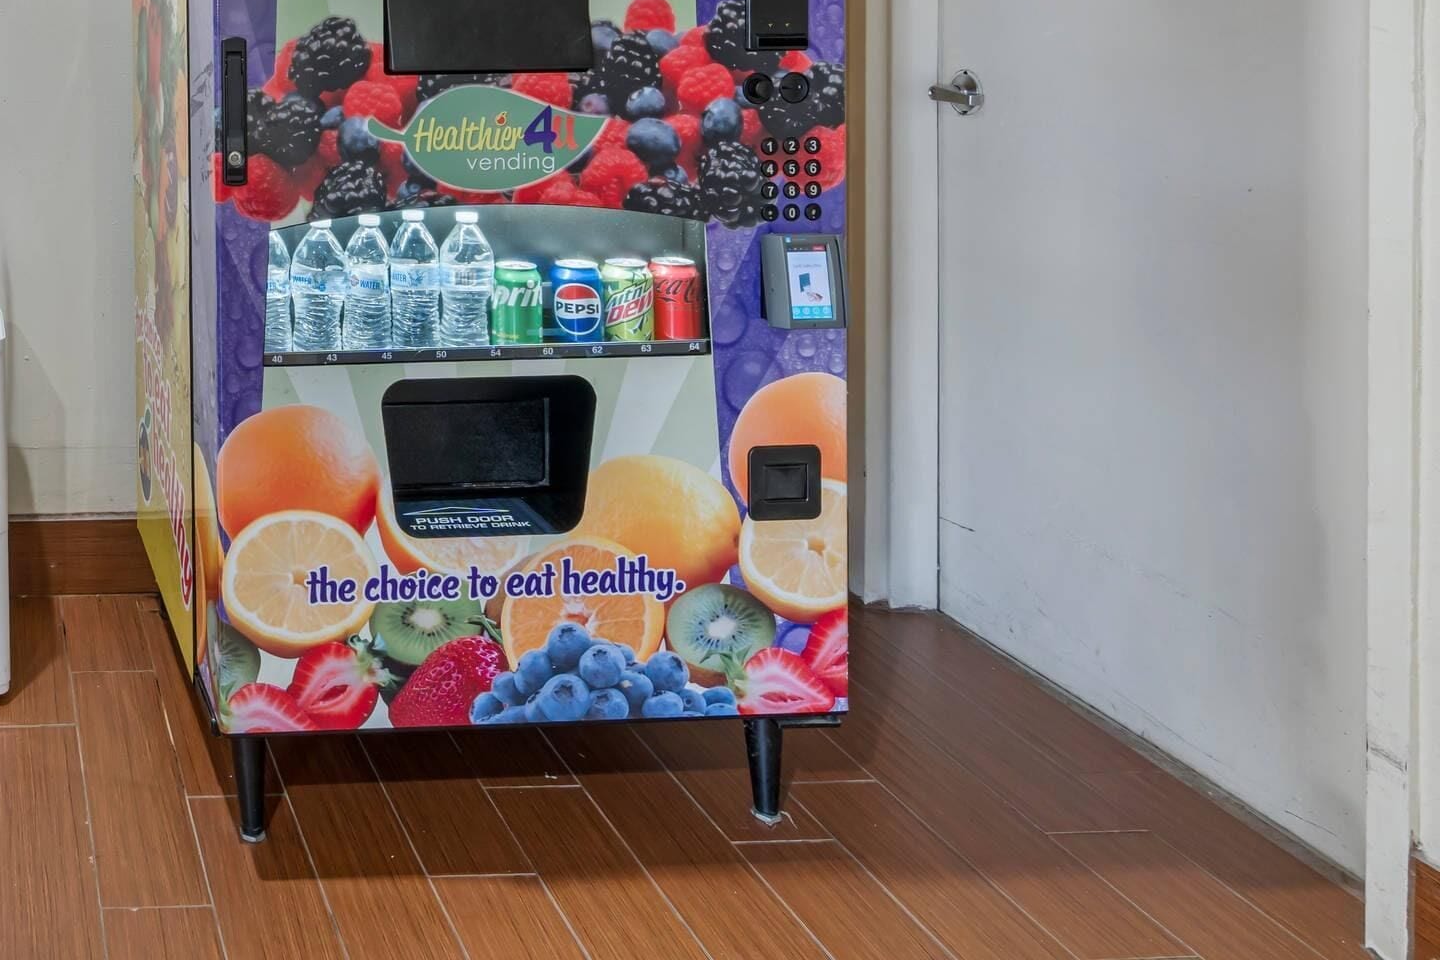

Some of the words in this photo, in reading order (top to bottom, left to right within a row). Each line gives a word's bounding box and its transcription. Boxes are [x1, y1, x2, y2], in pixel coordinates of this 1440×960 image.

[767, 141, 773, 152] 1
[788, 141, 796, 151] 2
[809, 140, 817, 151] 3
[466, 153, 556, 173] vending
[767, 164, 774, 174] 4
[789, 164, 796, 174] 5
[810, 163, 817, 173] 6
[768, 186, 774, 197] 7
[788, 186, 796, 196] 8
[810, 185, 817, 195] 9
[789, 208, 796, 218] 0
[360, 279, 380, 290] WATER
[556, 301, 600, 315] PEPSI
[543, 347, 554, 355] 60
[592, 346, 603, 354] 62
[641, 345, 652, 353] 63
[689, 343, 700, 351] 64
[326, 353, 338, 362] 43
[381, 352, 393, 360] 45
[436, 350, 447, 358] 50
[490, 349, 501, 357] 54
[272, 355, 283, 364] 40
[153, 401, 193, 610] healthy
[415, 516, 462, 524] PUSH
[467, 514, 514, 523] DOOR
[306, 566, 355, 604] the
[364, 564, 459, 601] choice
[467, 565, 498, 599] to
[506, 561, 556, 596] eat
[562, 555, 685, 601] healthy.
